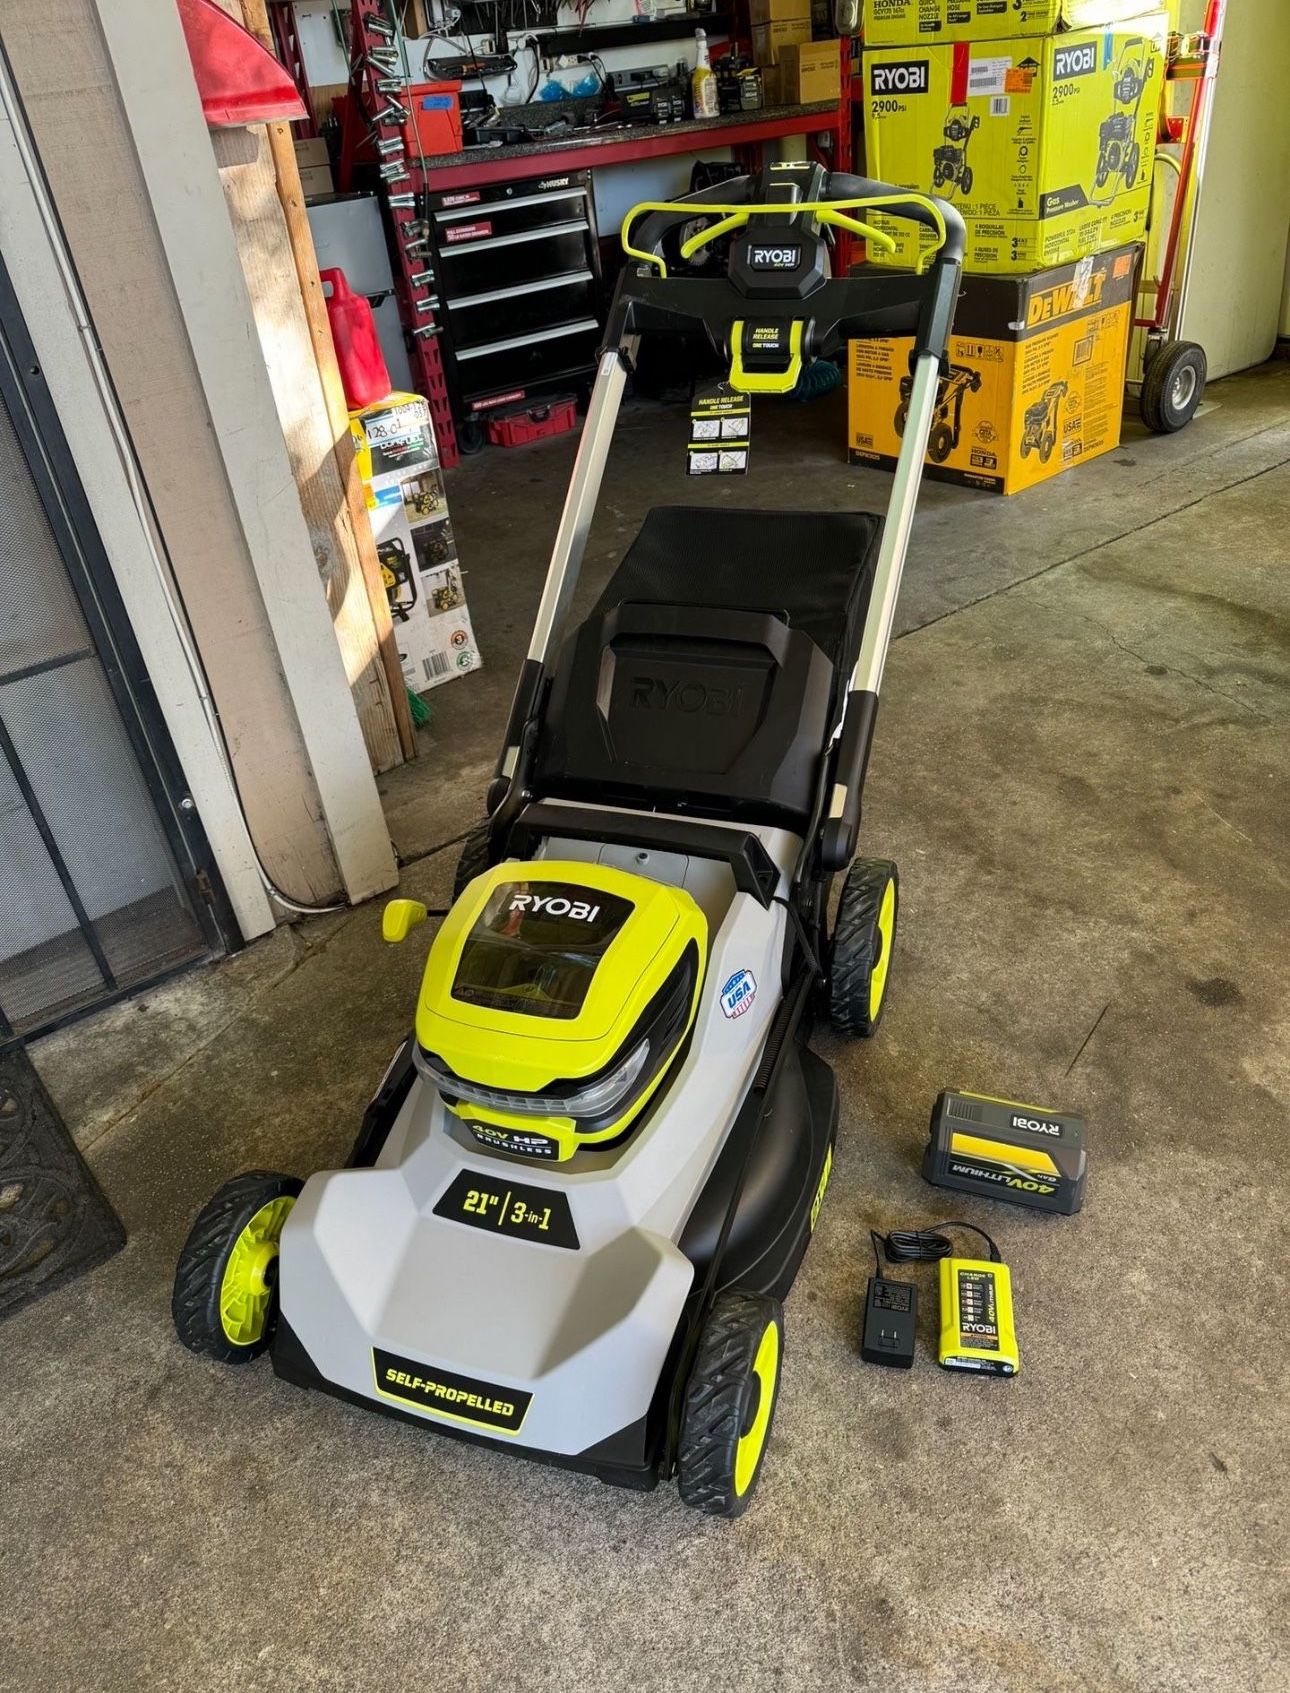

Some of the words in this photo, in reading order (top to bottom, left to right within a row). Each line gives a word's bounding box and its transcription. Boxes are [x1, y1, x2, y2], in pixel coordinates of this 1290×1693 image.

[1055, 47, 1095, 75] RYOBI
[873, 66, 925, 90] RYOBI
[1052, 83, 1074, 99] 2900
[872, 100, 898, 113] 2900
[1047, 196, 1060, 206] Gas
[1012, 237, 1018, 248] 3
[754, 249, 797, 264] RYOBI
[1011, 251, 1018, 261] 3
[1026, 270, 1107, 327] DEWLT
[699, 397, 720, 405] HANDLE
[632, 676, 742, 717] RYOBI
[508, 895, 601, 923] RYOBI
[728, 980, 751, 1008] USA
[472, 1125, 508, 1139] 40V
[513, 1136, 549, 1145] HP
[1013, 1116, 1060, 1136] RYOBI
[476, 1133, 552, 1154] BRUSHLESS
[463, 1190, 499, 1215] 21"
[510, 1201, 552, 1230] 3-in-1
[962, 1322, 997, 1334] RYOBI
[385, 1368, 514, 1417] SELF-PROPELLED
